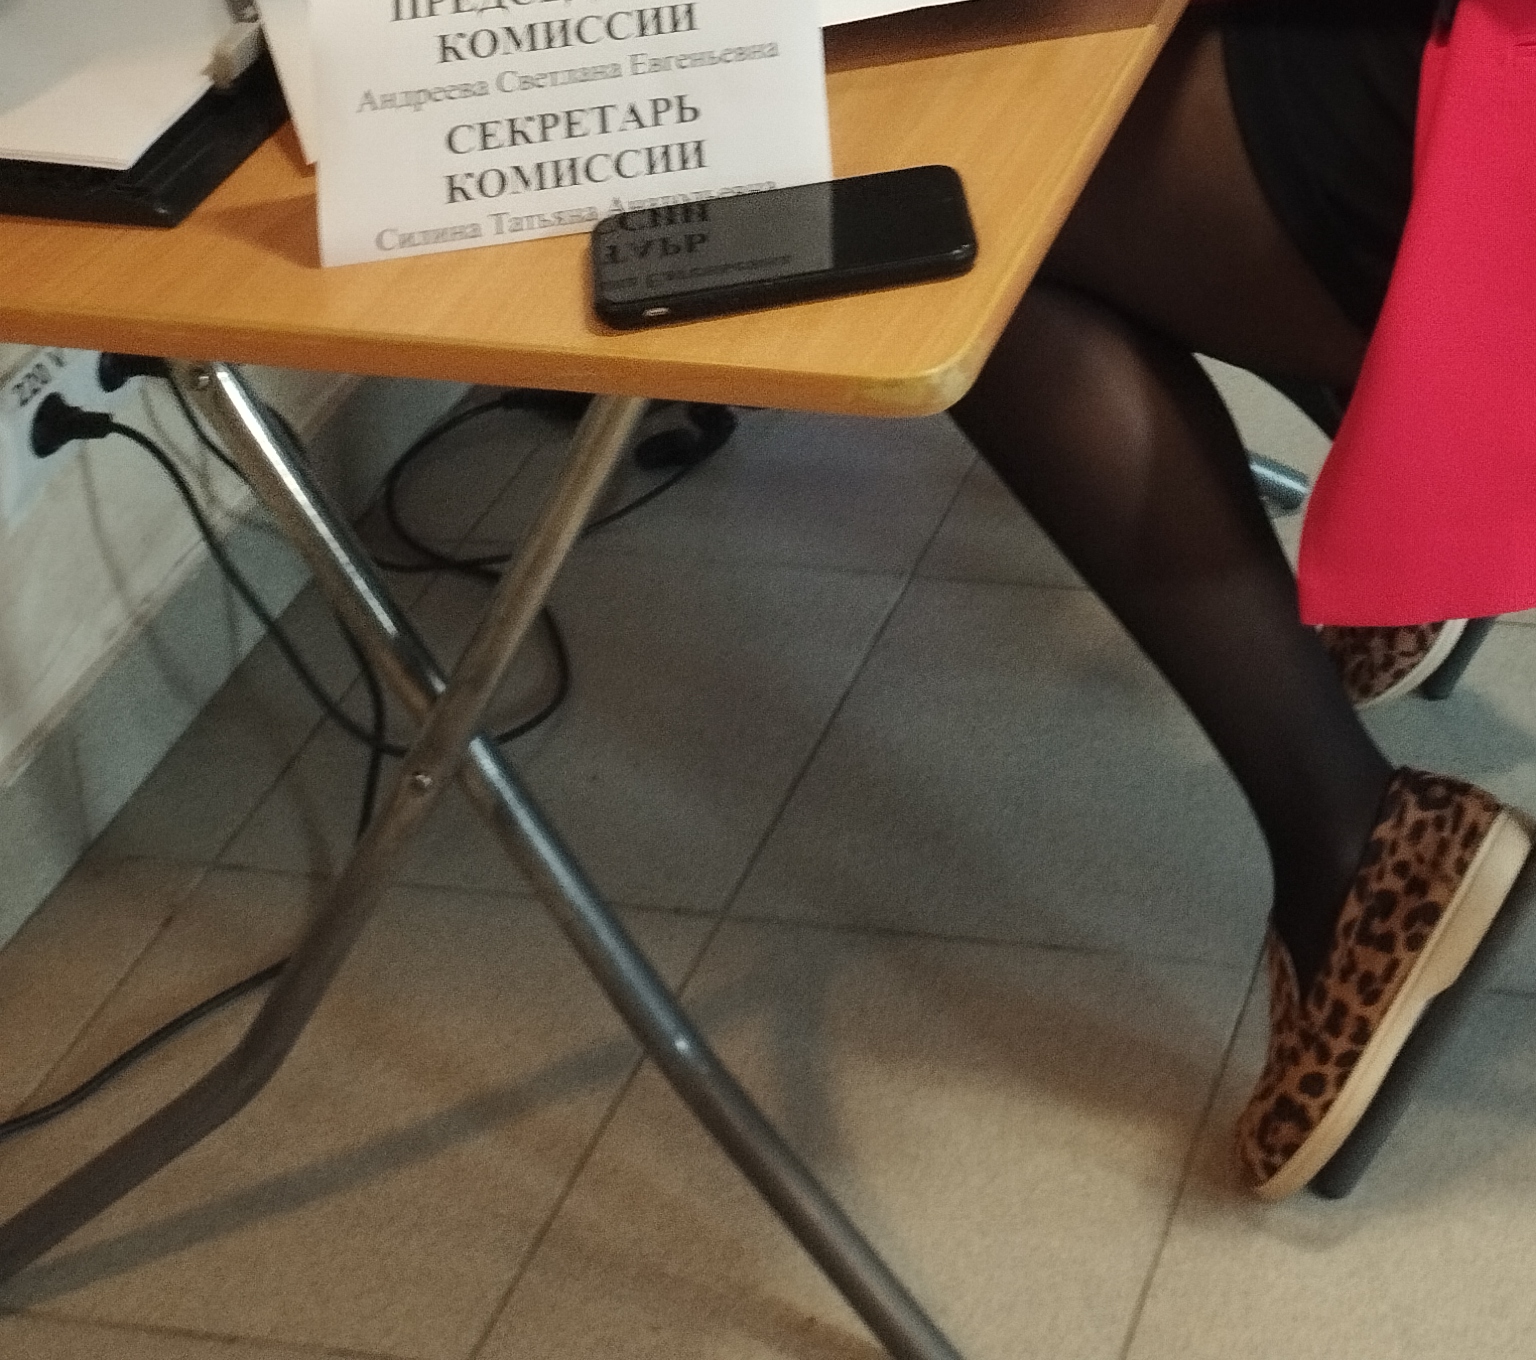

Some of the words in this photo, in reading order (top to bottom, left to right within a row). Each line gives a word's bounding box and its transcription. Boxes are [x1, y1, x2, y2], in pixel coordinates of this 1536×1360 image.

[435, 1, 701, 64] КОМИССИИ
[356, 78, 491, 114] Андреева
[495, 59, 623, 94] Светлана
[627, 38, 781, 77] Евгеньевна
[444, 93, 702, 155] СЕКРЕТАРЬ
[443, 139, 710, 204] КОМИССИИ
[374, 222, 484, 252] Силина
[487, 205, 599, 236] Татьяна
